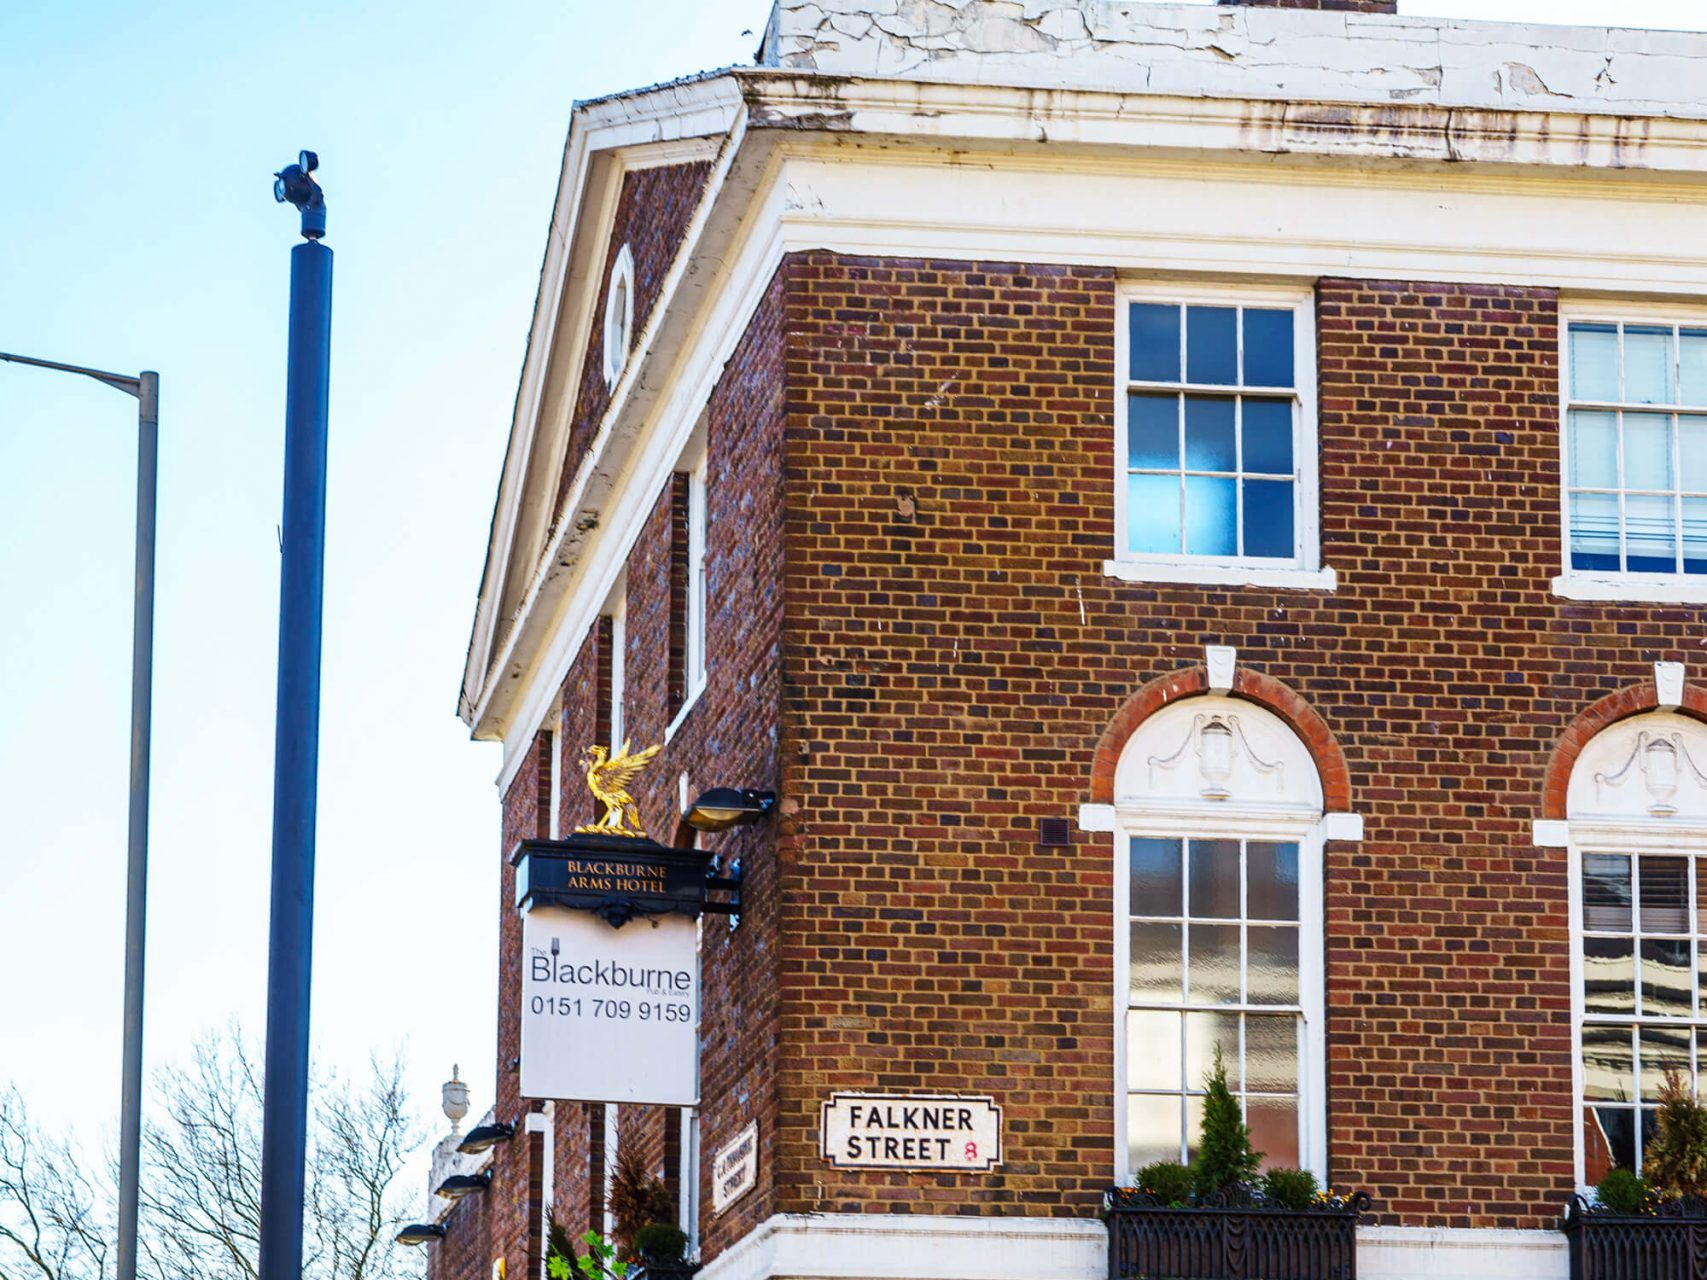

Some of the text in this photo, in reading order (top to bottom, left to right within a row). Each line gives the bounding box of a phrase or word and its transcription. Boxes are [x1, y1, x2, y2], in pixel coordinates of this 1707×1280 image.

[567, 860, 667, 879] BLACKBURNE
[568, 876, 667, 894] ARMS HOTEL
[531, 937, 691, 990] Blackburne
[531, 996, 691, 1022] 0151 709 9159
[850, 1106, 973, 1130] FALKNER
[846, 1135, 978, 1162] STREET 8
